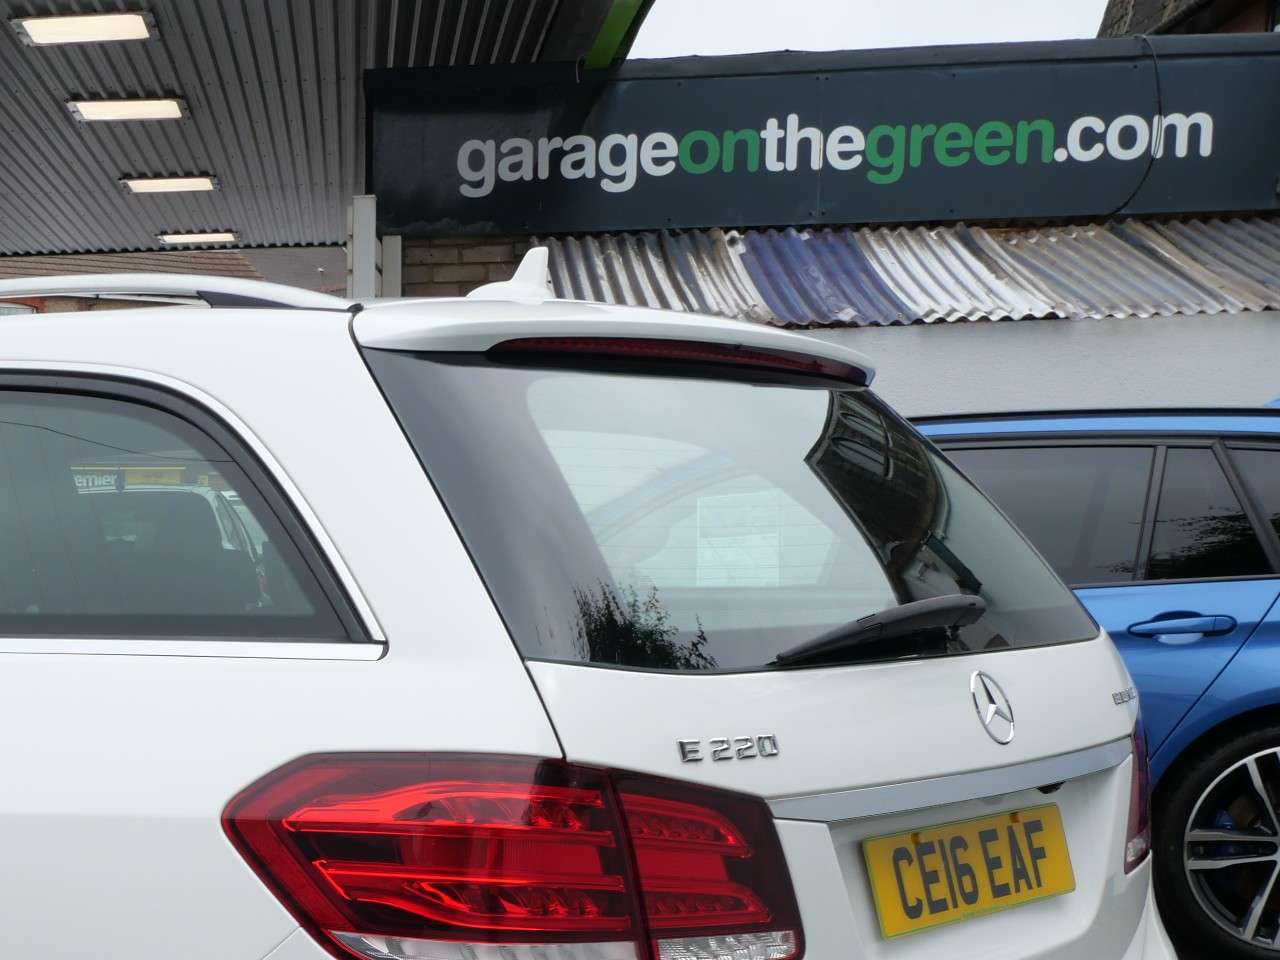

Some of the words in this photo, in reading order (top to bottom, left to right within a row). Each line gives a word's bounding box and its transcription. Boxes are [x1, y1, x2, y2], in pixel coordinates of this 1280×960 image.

[457, 112, 1213, 198] garageonthegreen.com
[677, 739, 704, 763] E
[709, 735, 779, 762] 220
[892, 835, 979, 919] CE16
[978, 819, 1047, 899] EAF
